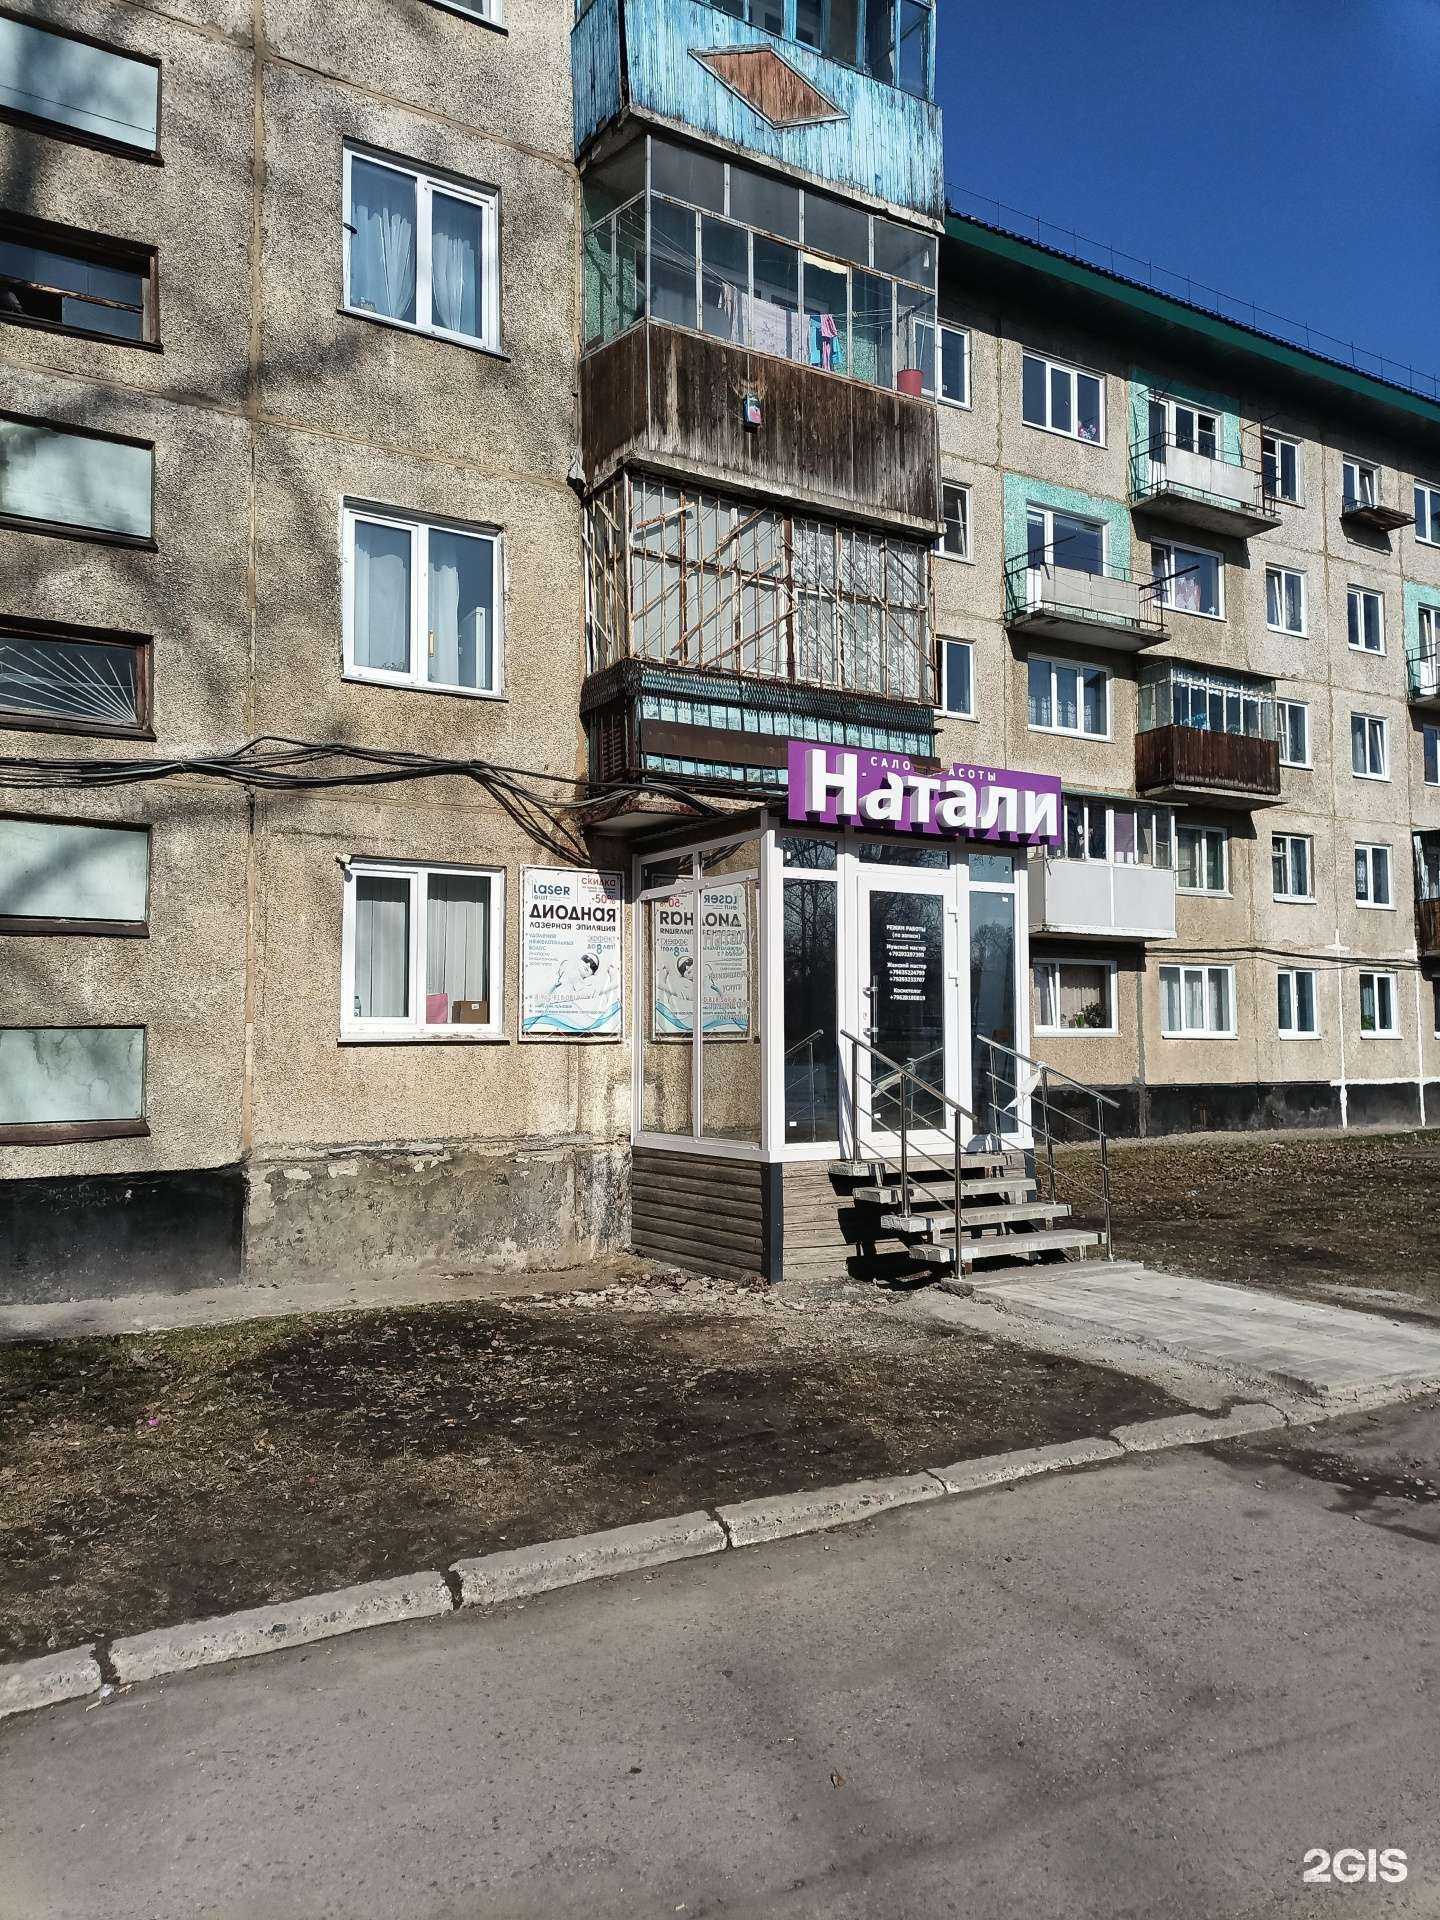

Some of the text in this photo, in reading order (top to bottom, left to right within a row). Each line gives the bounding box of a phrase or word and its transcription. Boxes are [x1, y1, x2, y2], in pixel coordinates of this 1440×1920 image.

[870, 756, 996, 782] САЛО АСОТЫ
[805, 748, 1058, 836] Натали
[596, 943, 603, 954] 8
